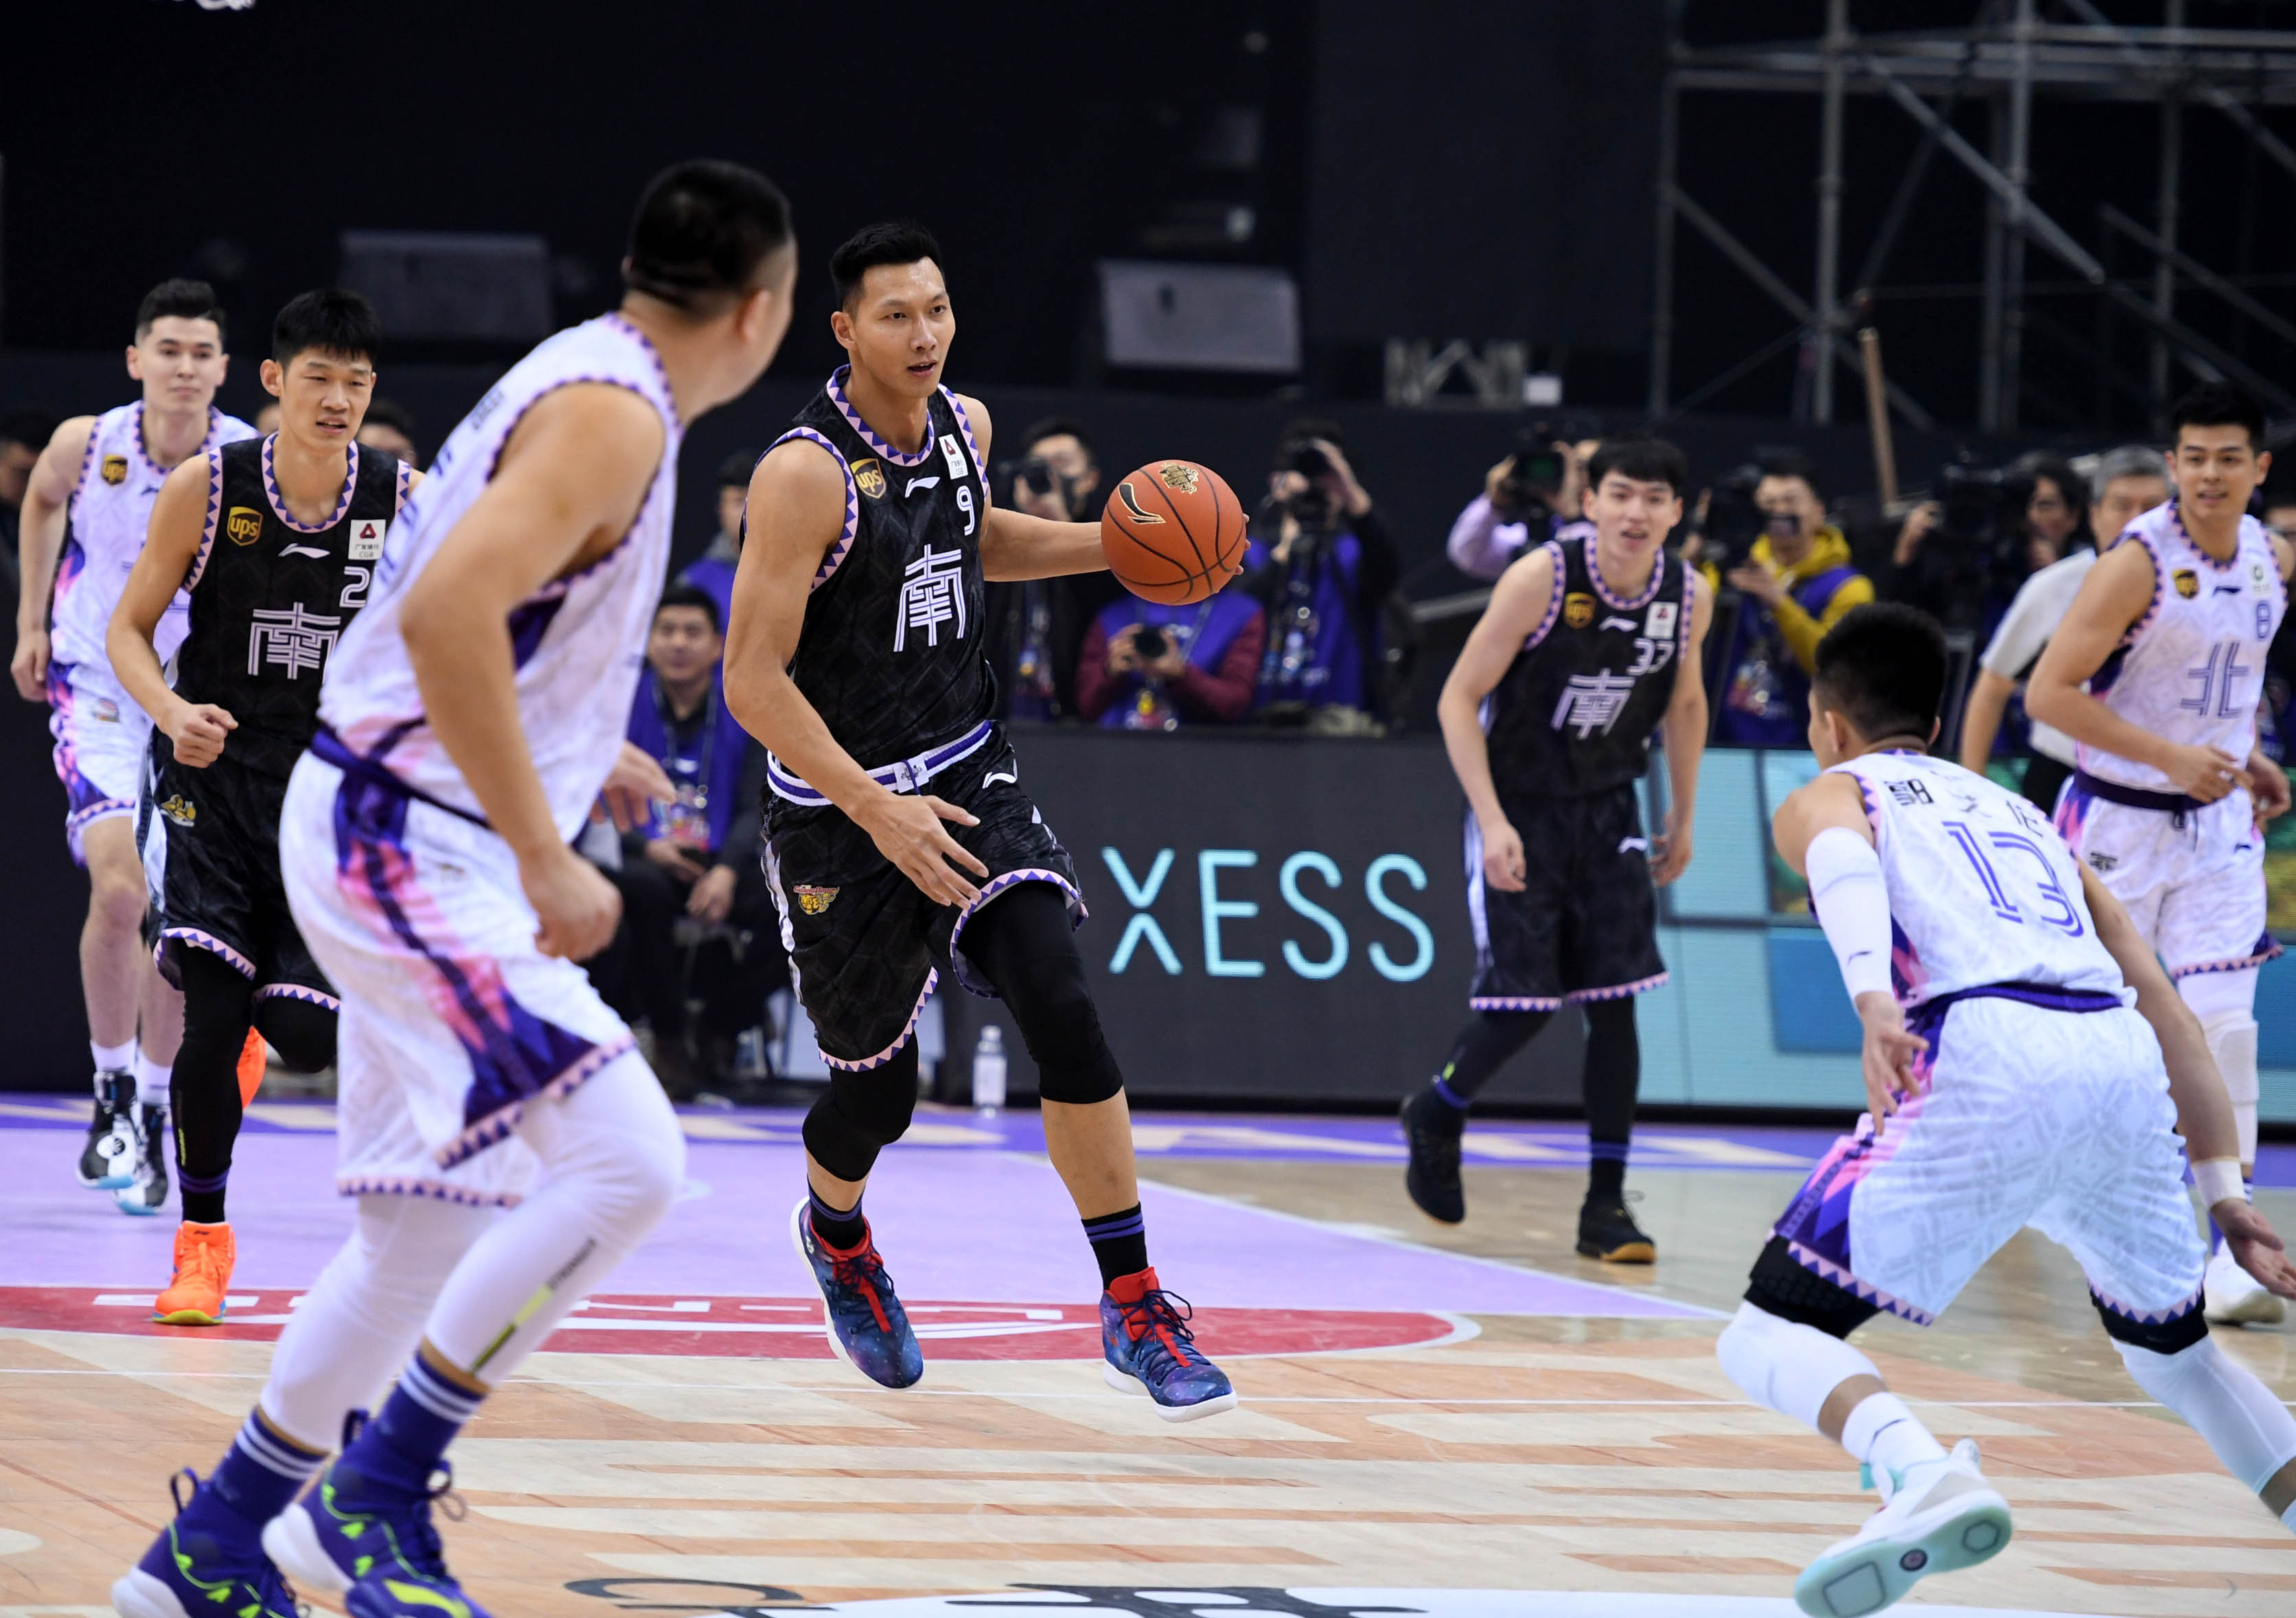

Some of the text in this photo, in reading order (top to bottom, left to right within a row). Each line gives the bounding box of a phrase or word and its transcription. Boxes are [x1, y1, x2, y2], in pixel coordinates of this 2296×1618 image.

[856, 470, 882, 493] ups
[956, 485, 975, 536] 9
[231, 516, 259, 540] ups
[893, 543, 966, 652] 南
[2256, 600, 2271, 640] 8
[247, 602, 341, 680] 南
[1550, 668, 1635, 740] 南
[2179, 641, 2251, 719] 北
[1101, 846, 1435, 982] XESS
[1941, 821, 2085, 937] 13
